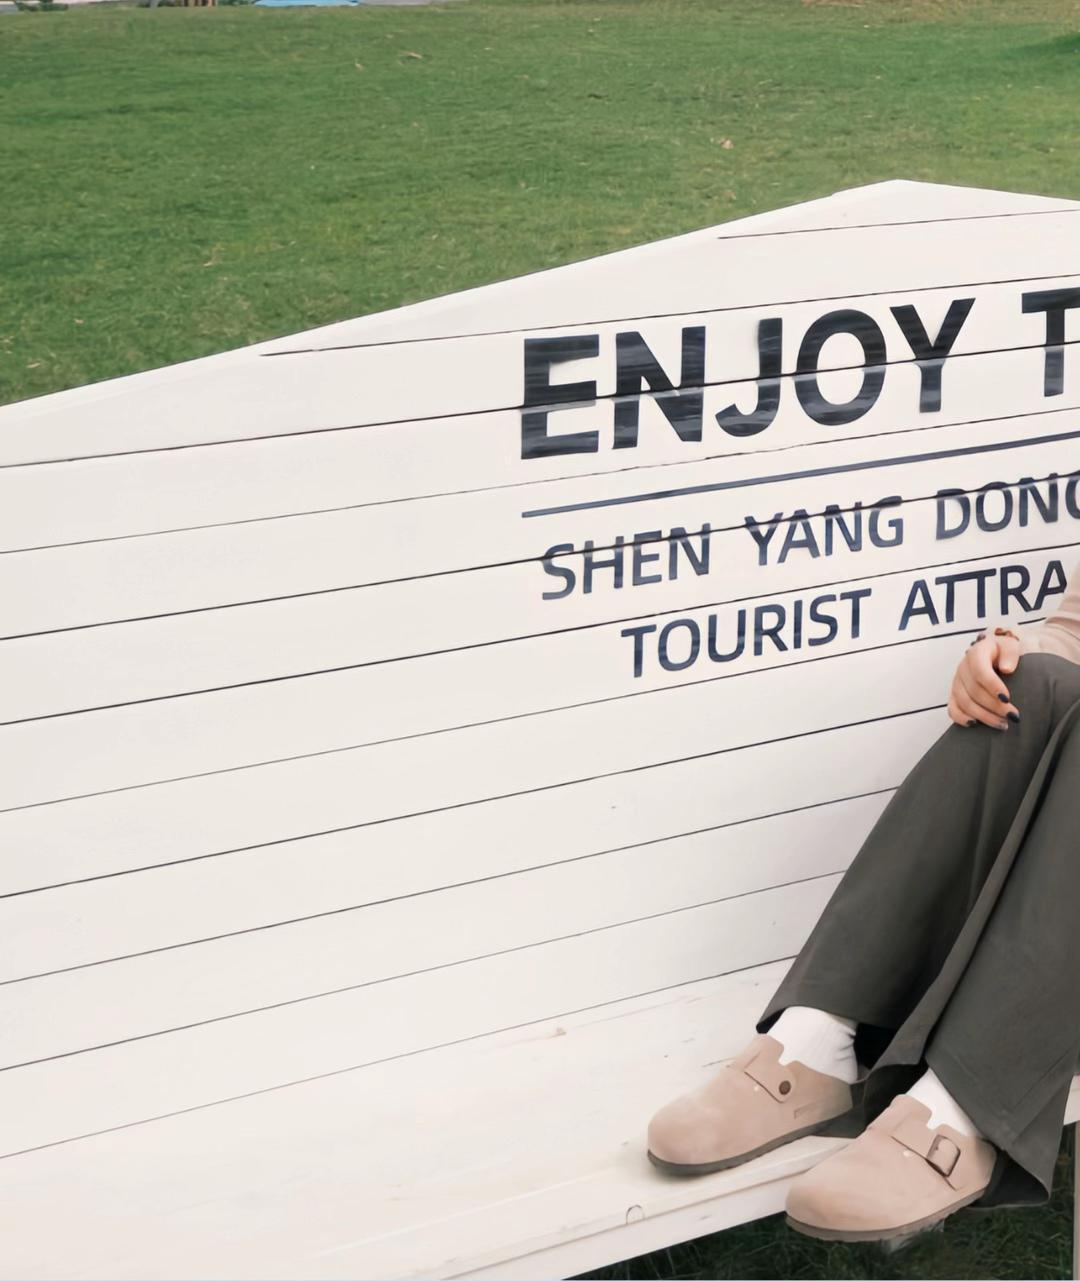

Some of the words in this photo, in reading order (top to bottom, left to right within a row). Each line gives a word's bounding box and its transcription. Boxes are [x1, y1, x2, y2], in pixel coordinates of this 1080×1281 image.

[521, 298, 976, 460] ENJOY
[541, 522, 711, 601] SHEN
[744, 494, 905, 568] YANG
[621, 587, 872, 679] TOURIST
